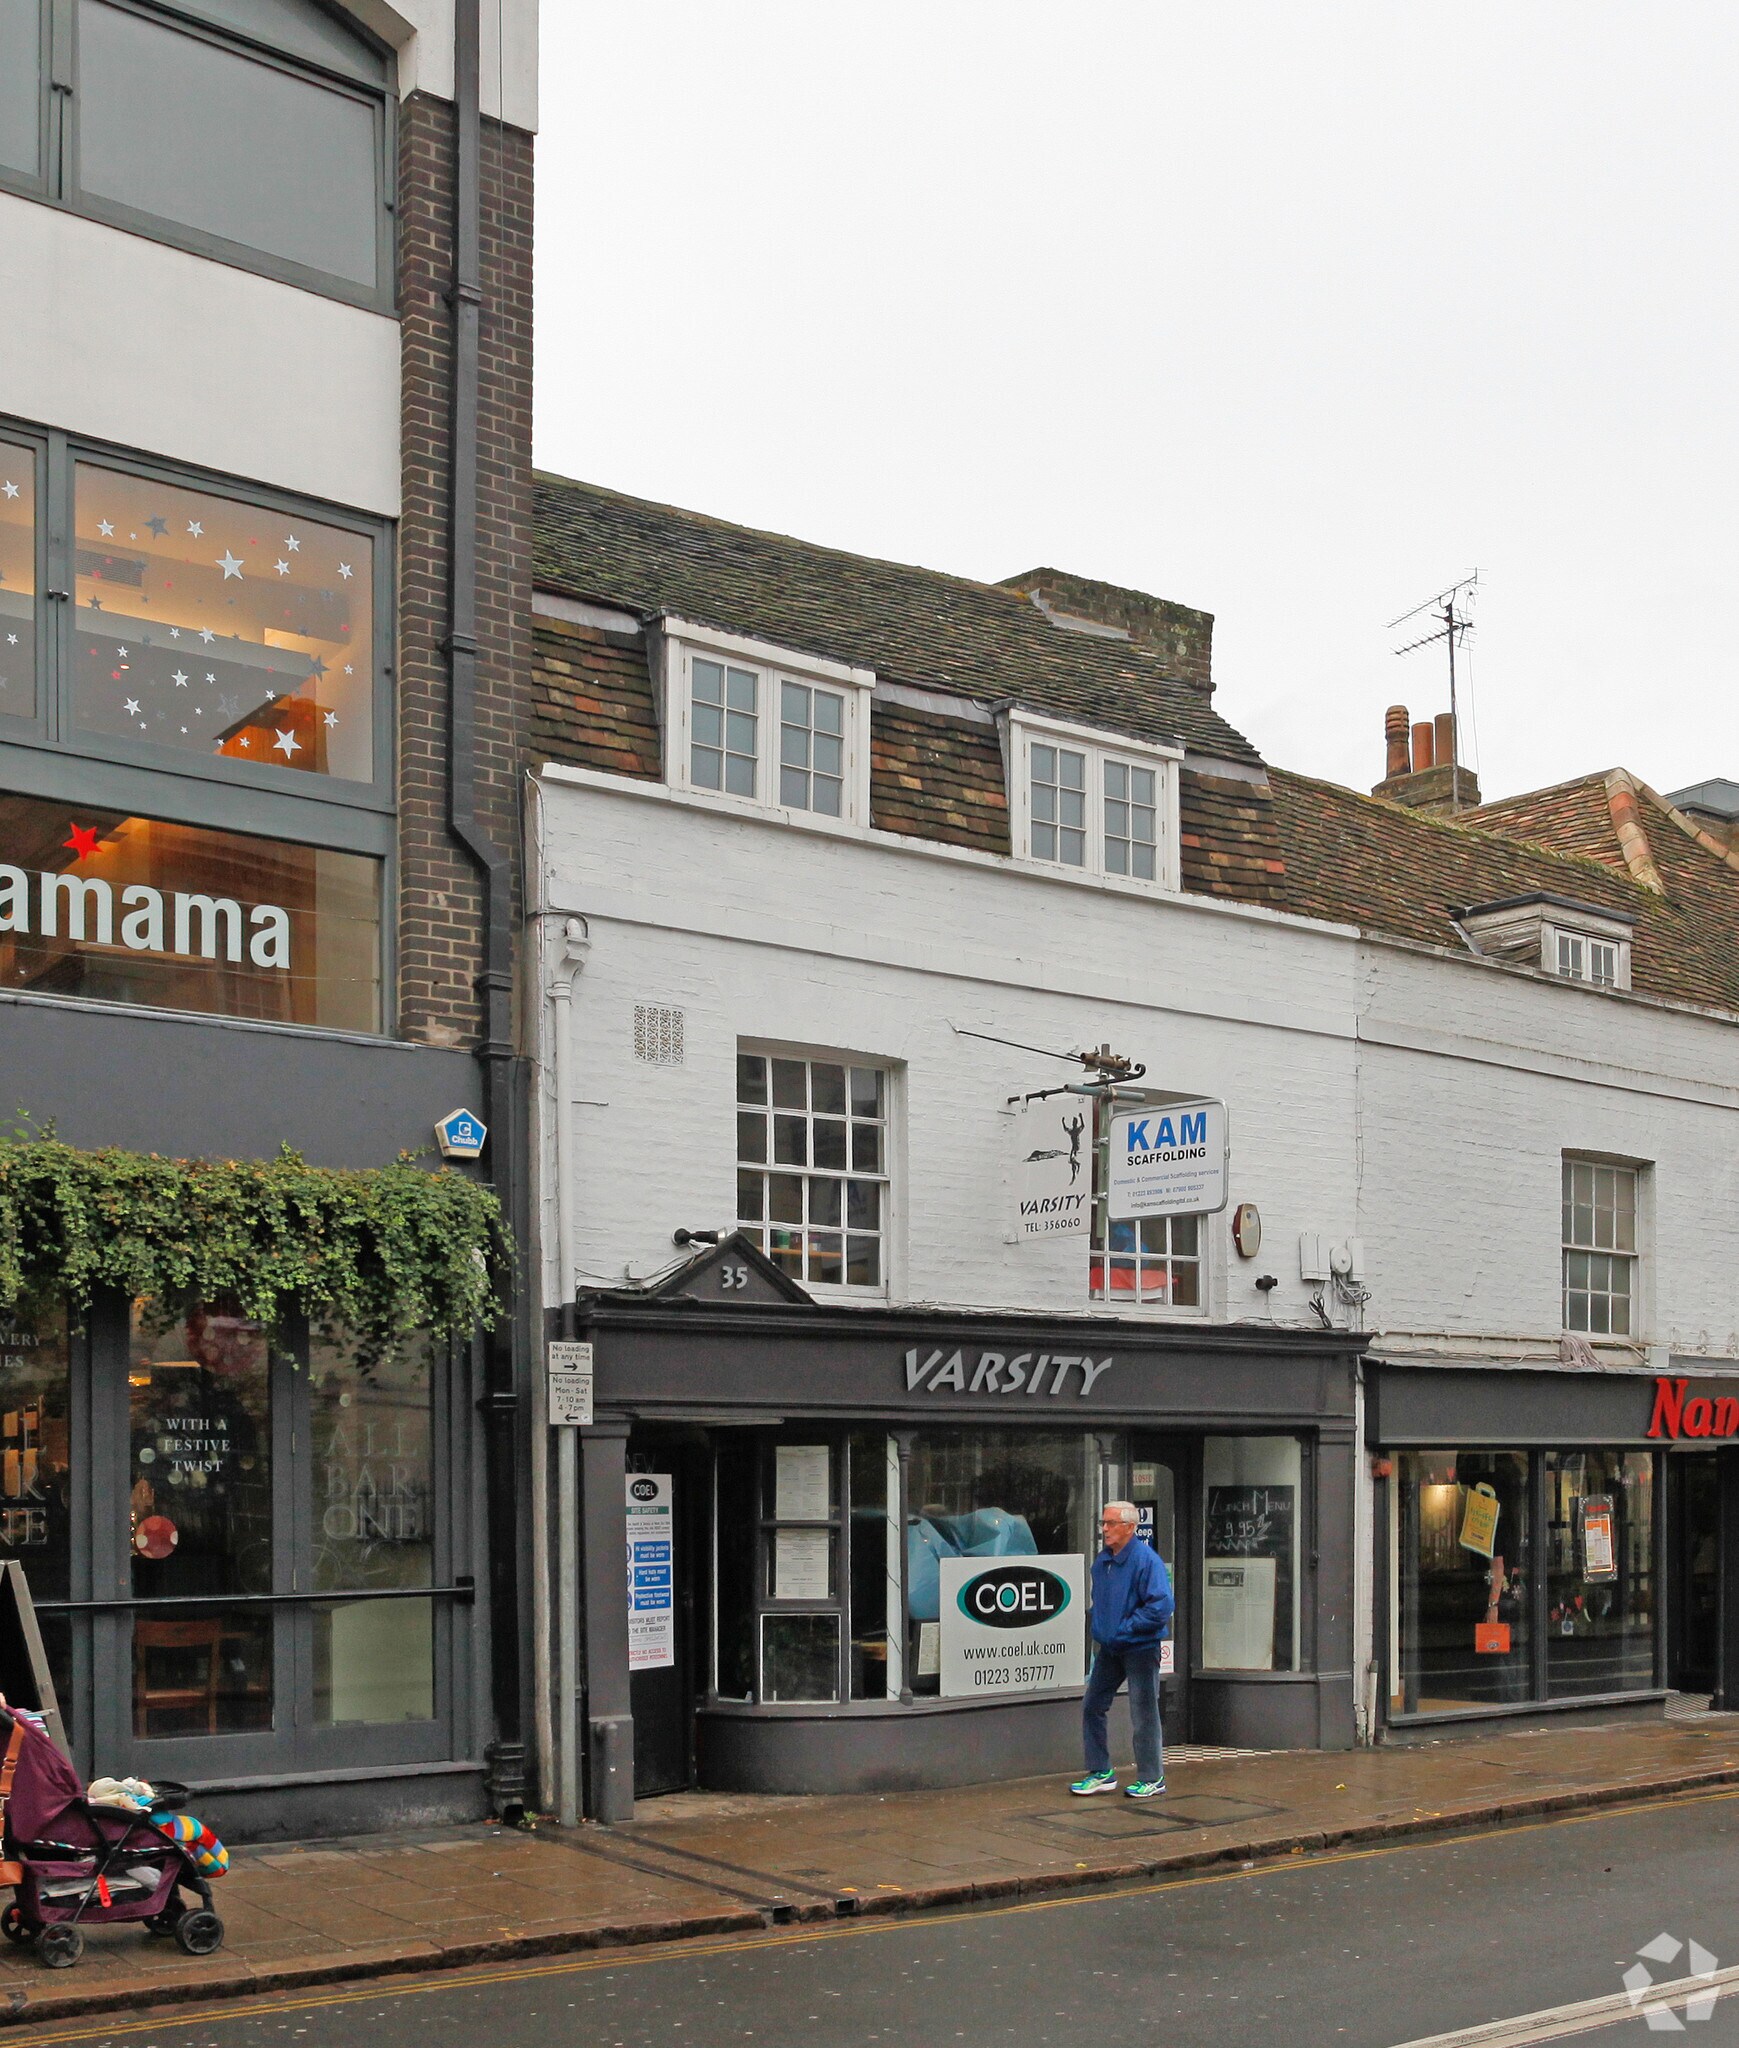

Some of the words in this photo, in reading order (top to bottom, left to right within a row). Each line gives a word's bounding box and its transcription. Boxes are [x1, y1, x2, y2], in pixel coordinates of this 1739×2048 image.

[0, 863, 291, 970] amama
[451, 1135, 478, 1145] Chubb
[1127, 1111, 1207, 1153] KAM
[1127, 1147, 1206, 1167] SCAFFOLDING
[1113, 1177, 1136, 1186] Domestic
[1141, 1174, 1169, 1183] Commercial
[1170, 1170, 1197, 1180] Scaffolding
[1198, 1168, 1219, 1176] services
[1020, 1193, 1086, 1216] VARSITY
[1024, 1222, 1042, 1233] TEL:
[1044, 1217, 1081, 1231] 356060
[722, 1265, 748, 1289] 35
[564, 1344, 590, 1353] loading
[564, 1376, 590, 1385] loading
[905, 1348, 1113, 1396] VARSITY
[1646, 1377, 1739, 1439] Nan
[166, 1418, 209, 1430] WITH
[217, 1418, 227, 1431] A
[164, 1439, 230, 1452] FESTIVE
[323, 1422, 419, 1458] ALL
[172, 1460, 223, 1472] TWIST
[323, 1463, 417, 1498] BAR
[1133, 1474, 1153, 1483] LOSED
[633, 1484, 655, 1496] COEL
[322, 1503, 420, 1539] ONE
[975, 1582, 1055, 1614] COEL
[963, 1641, 1066, 1660] www.coel.uk.com
[974, 1668, 1010, 1686] 01223
[1014, 1665, 1055, 1683] 357777
